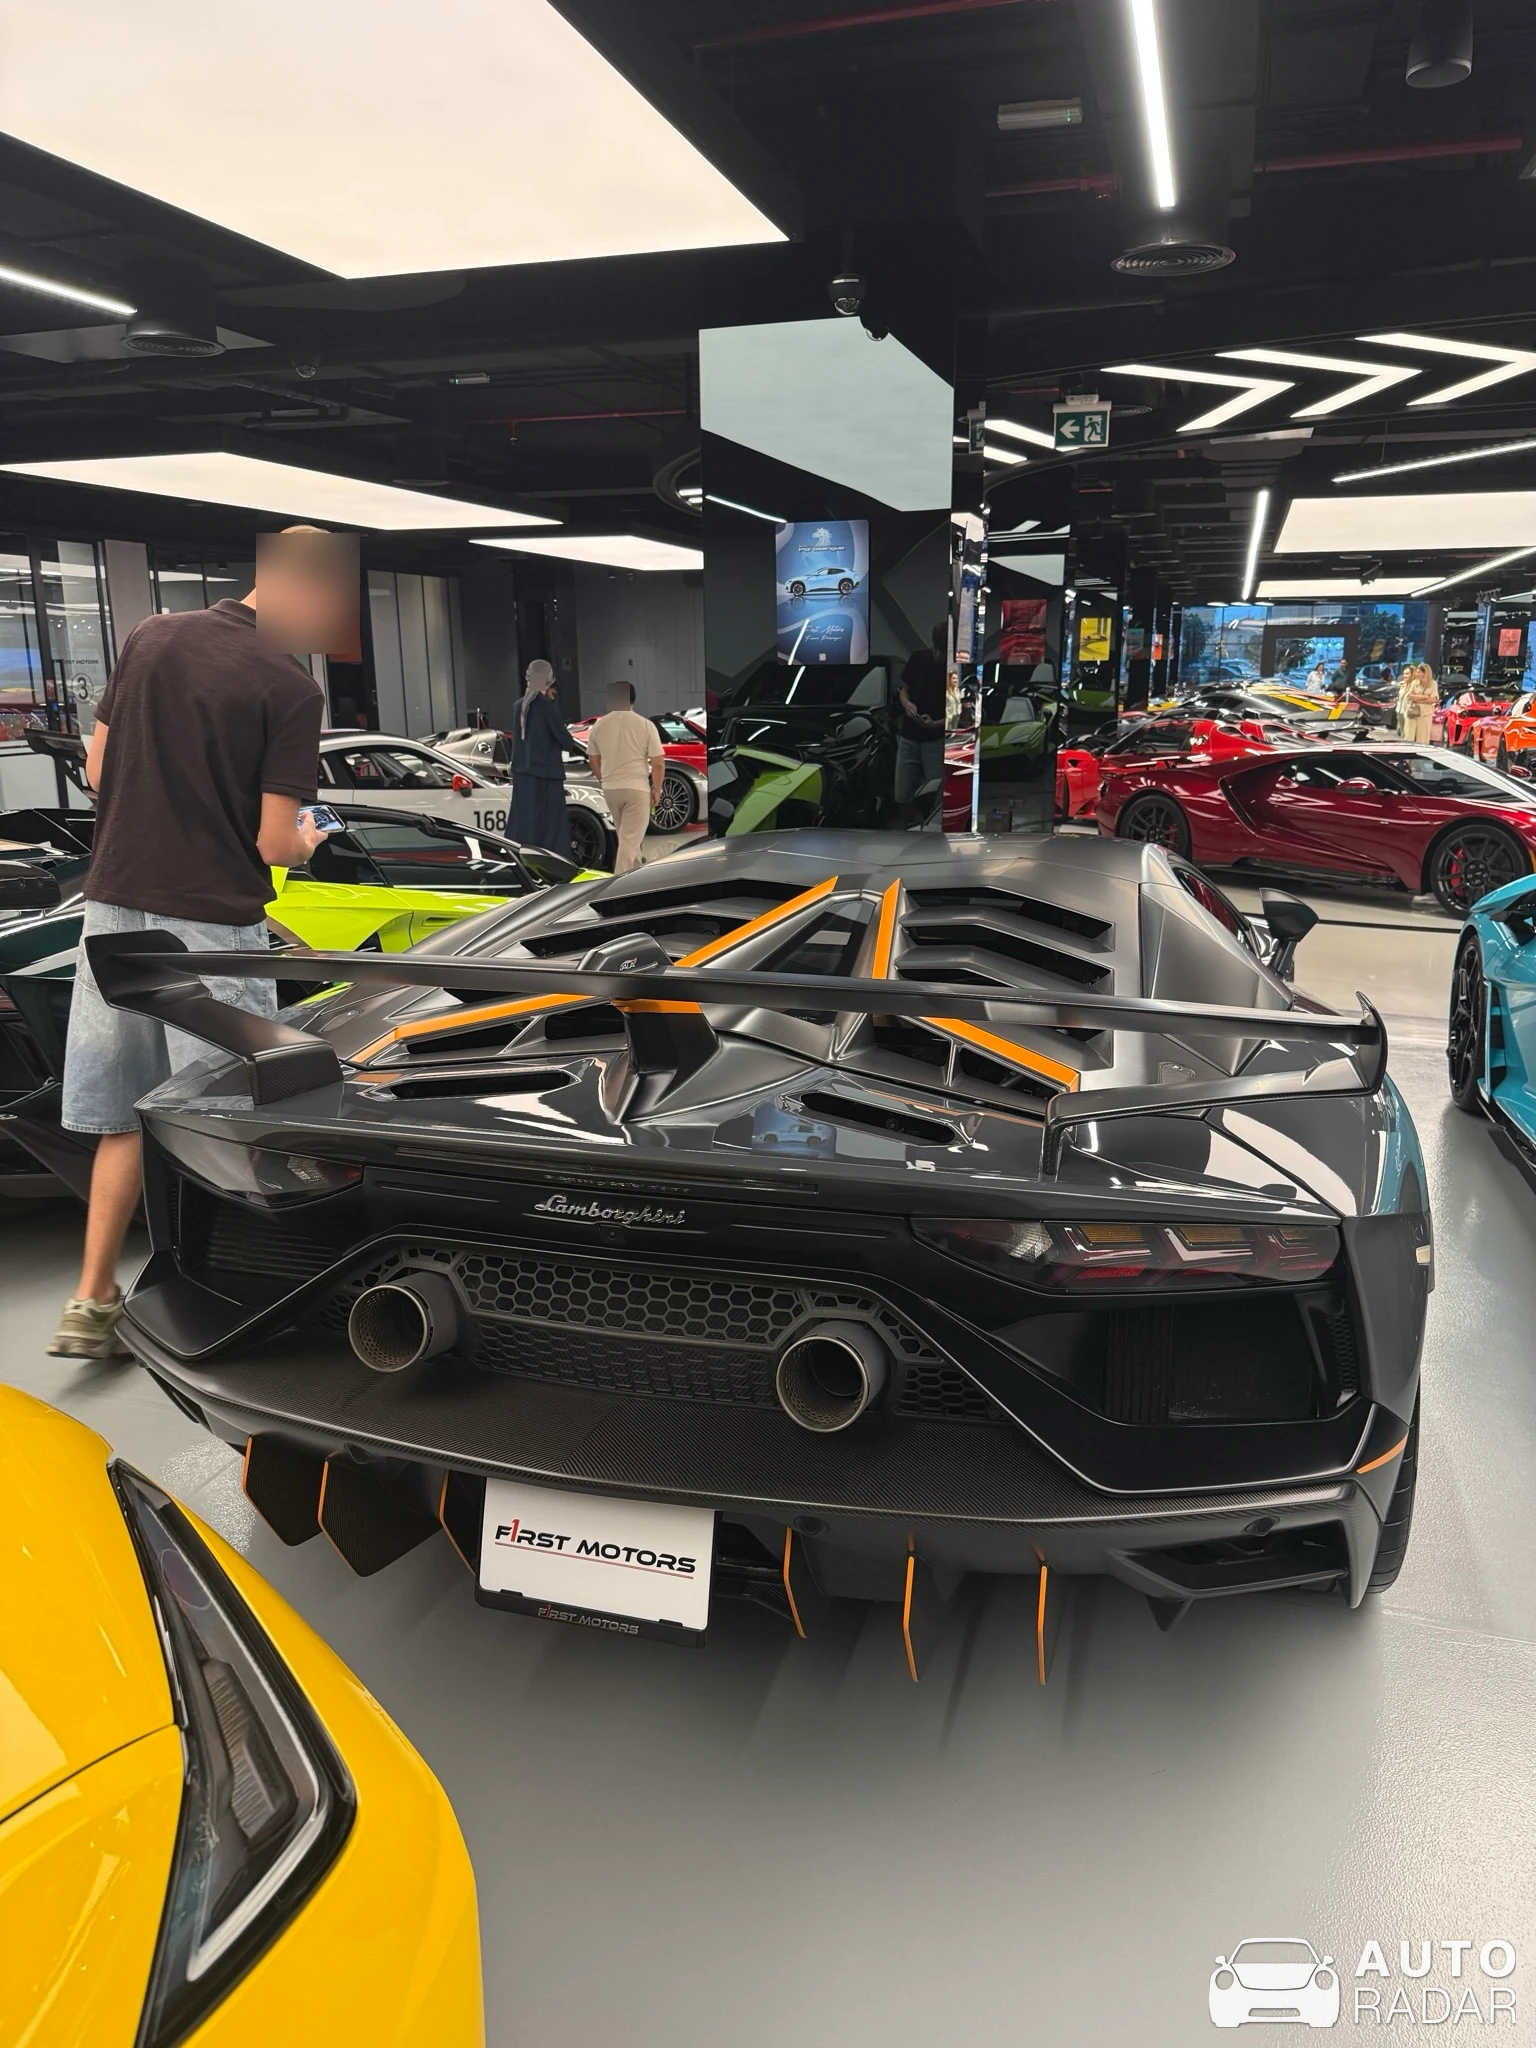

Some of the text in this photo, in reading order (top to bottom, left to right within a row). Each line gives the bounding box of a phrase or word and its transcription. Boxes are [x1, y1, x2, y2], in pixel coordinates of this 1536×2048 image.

[77, 676, 88, 699] 3
[473, 810, 507, 831] 168
[534, 1194, 686, 1224] Lamborghini
[576, 1539, 696, 1573] MOTORS
[578, 1614, 639, 1635] MOTORS
